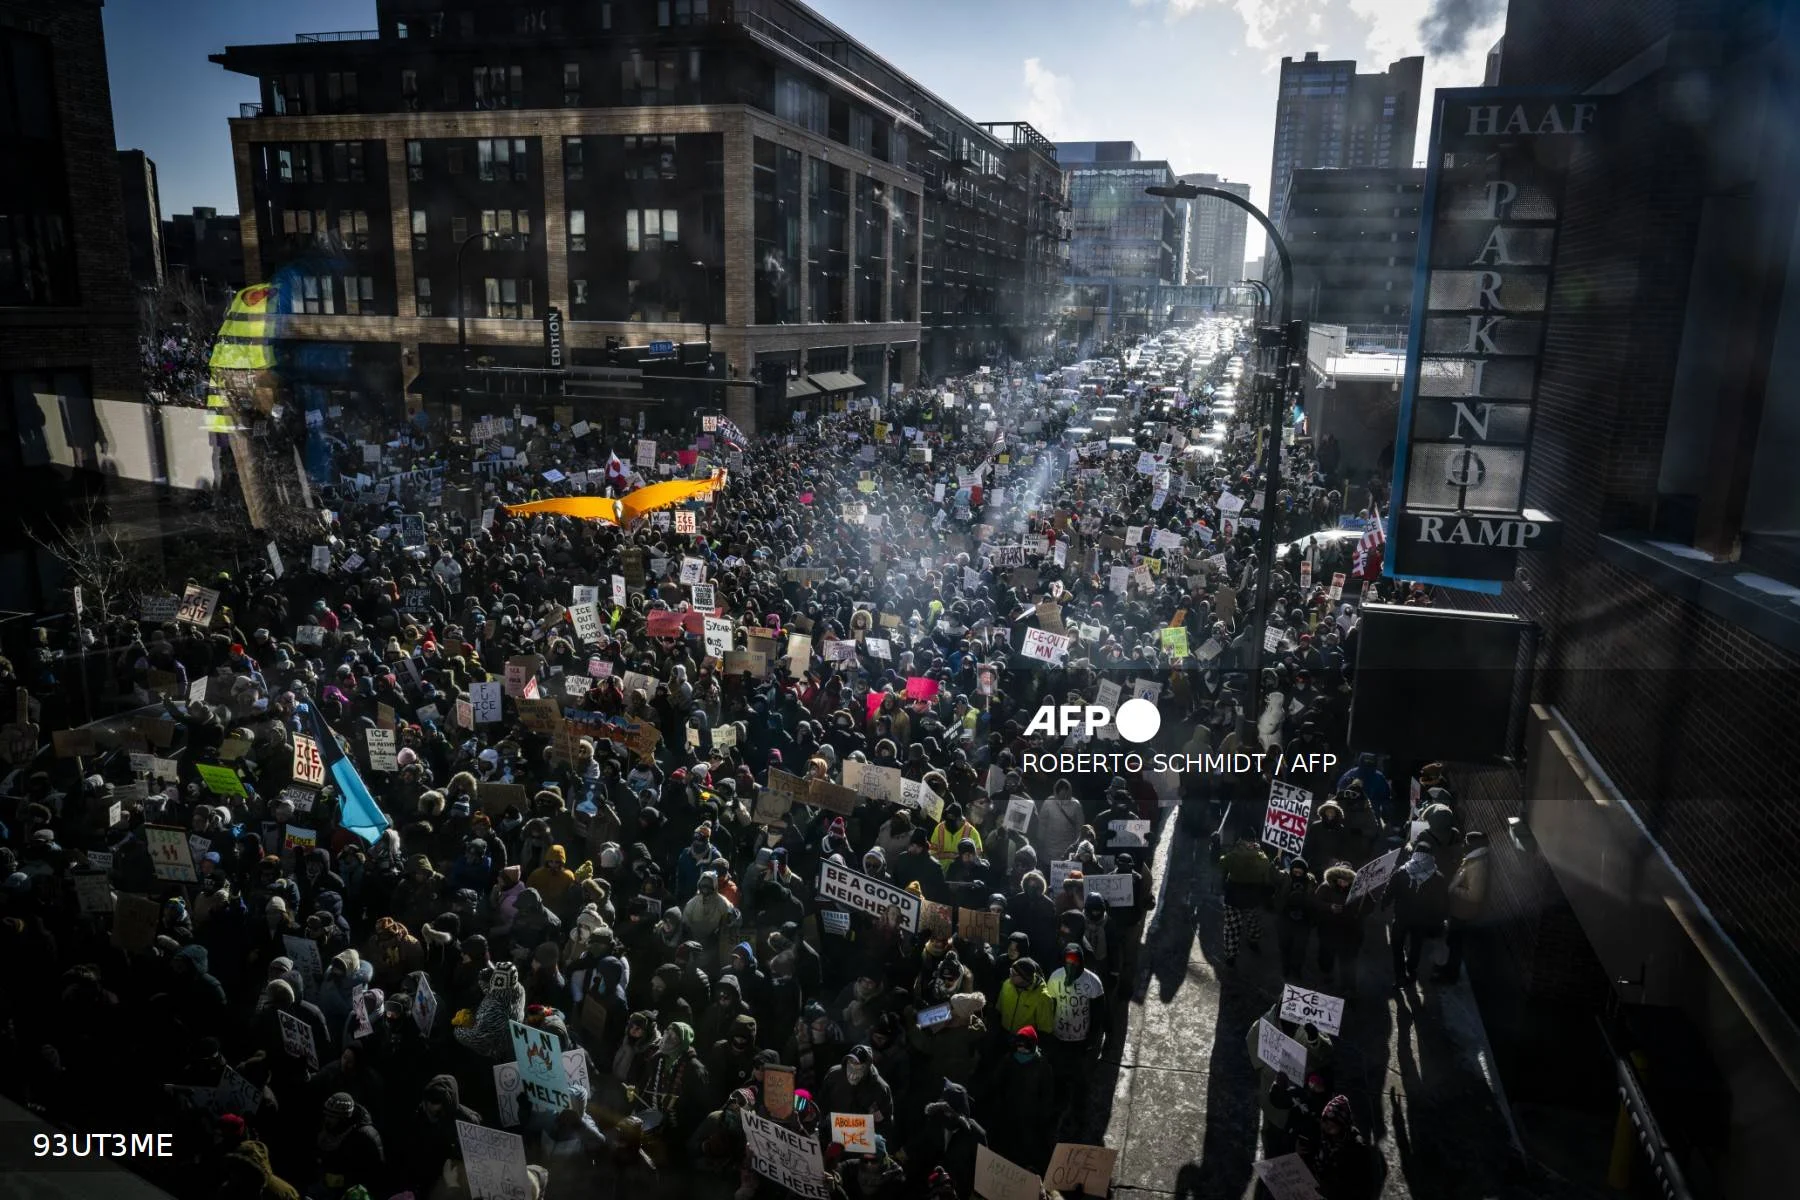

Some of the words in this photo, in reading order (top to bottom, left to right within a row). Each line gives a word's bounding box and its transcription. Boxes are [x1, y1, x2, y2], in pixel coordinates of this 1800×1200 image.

[1464, 103, 1597, 136] HAAF
[548, 312, 561, 366] EDITION
[1443, 180, 1517, 485] PARKING
[678, 516, 693, 524] ICE
[1416, 516, 1541, 548] RAMP
[184, 594, 210, 609] ICE
[576, 606, 591, 615] ICE
[180, 606, 207, 620] OUT!
[577, 615, 592, 623] OUT
[580, 623, 597, 631] FOR
[580, 632, 602, 640] GOOD
[1028, 630, 1067, 649] ICE-OUT
[1035, 646, 1053, 659] MN
[371, 730, 389, 738] ICE
[296, 744, 320, 765] ICE
[296, 762, 322, 782] OUT!
[1272, 781, 1306, 803] IT'S
[1269, 795, 1310, 818] GIVING
[1264, 825, 1303, 855] VIBES
[827, 867, 848, 885] BE
[850, 878, 861, 890] A
[864, 883, 911, 910] GOOD
[825, 882, 910, 928] NEIGHBR
[1286, 988, 1319, 1005] ICE
[522, 1079, 570, 1109] MELTS
[834, 1116, 866, 1129] ABOLISH
[743, 1112, 773, 1138] WE
[775, 1128, 818, 1156] MELT
[1066, 1146, 1094, 1169] ICE
[782, 1171, 830, 1200] HERE
[1052, 1166, 1098, 1186] OUT
